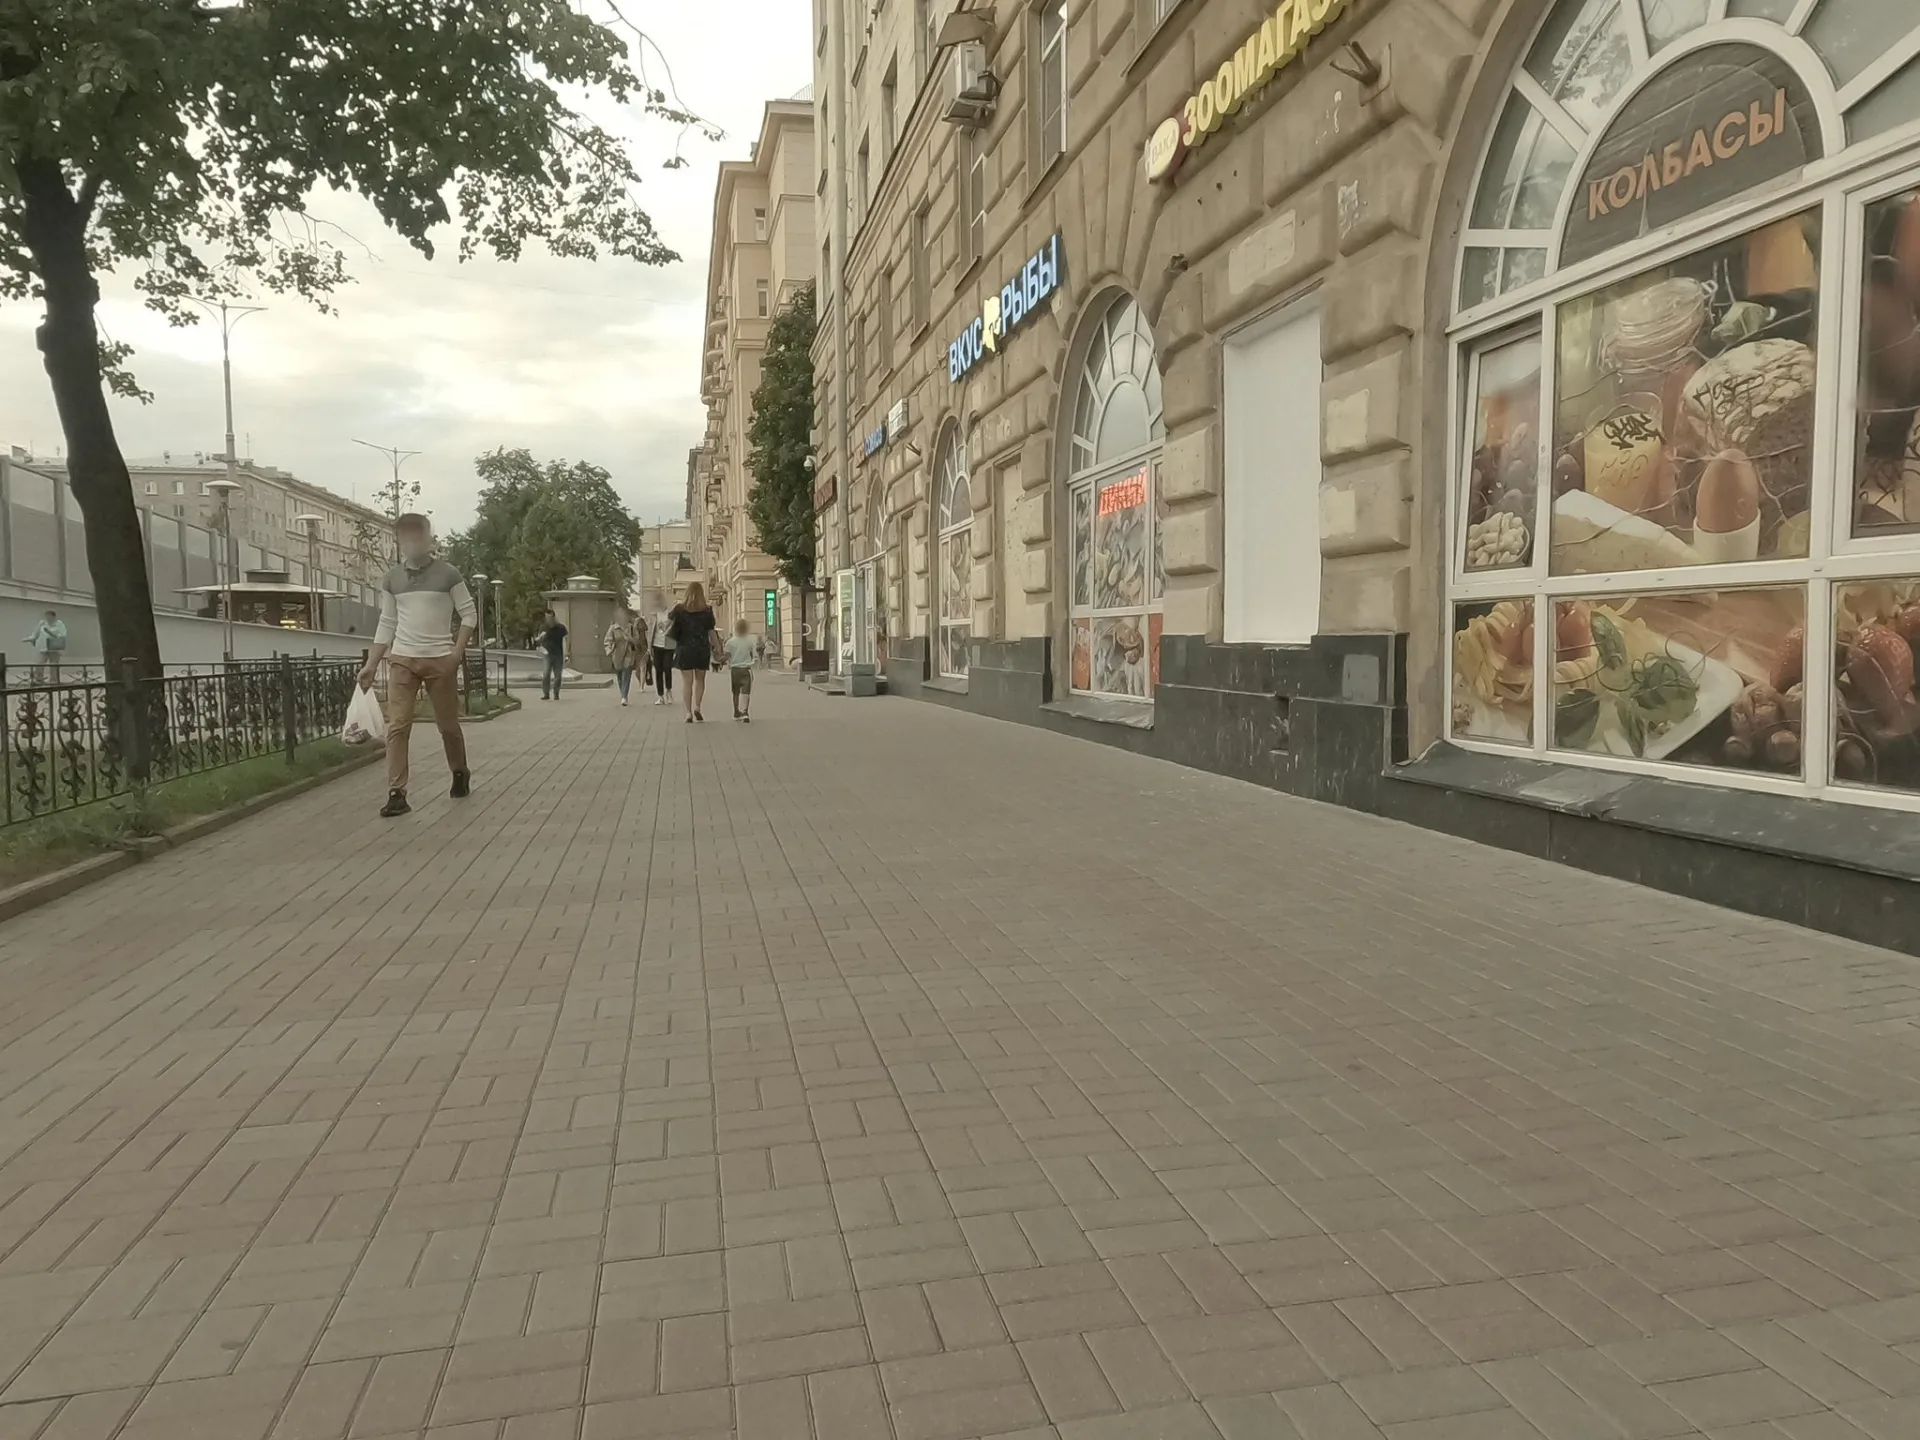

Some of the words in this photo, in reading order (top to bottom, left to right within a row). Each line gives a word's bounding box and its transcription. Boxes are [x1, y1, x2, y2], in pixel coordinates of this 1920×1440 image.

[1587, 87, 1787, 221] КОЛБАСЫ
[949, 316, 983, 382] ВКУС
[1001, 233, 1057, 337] РЫБЫ
